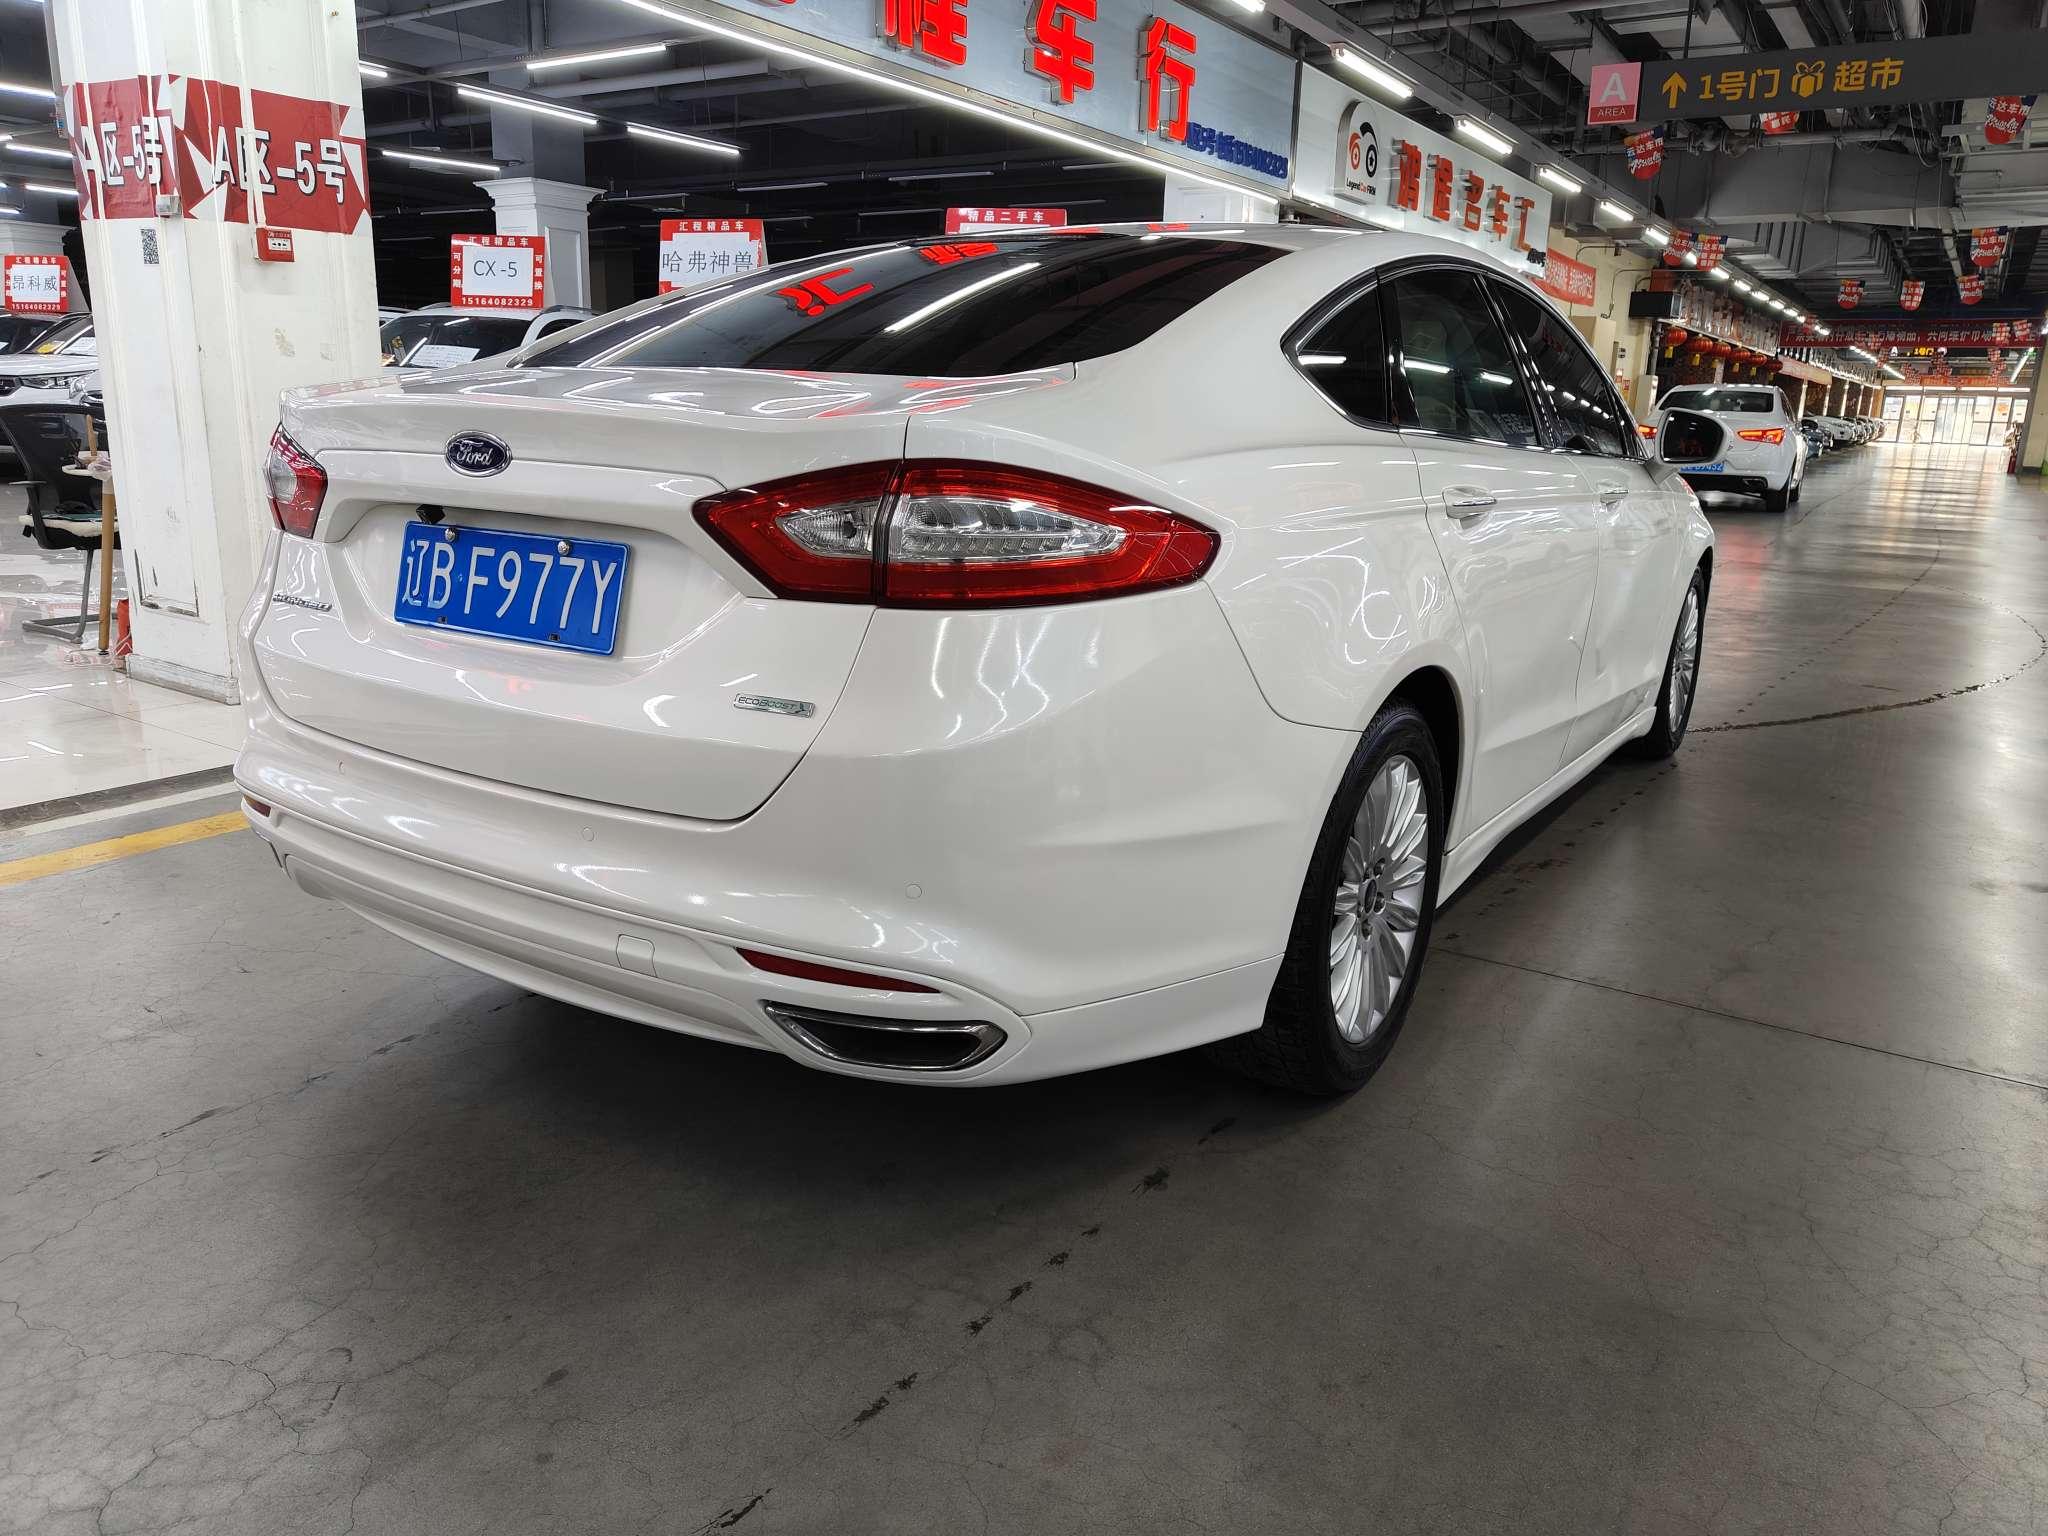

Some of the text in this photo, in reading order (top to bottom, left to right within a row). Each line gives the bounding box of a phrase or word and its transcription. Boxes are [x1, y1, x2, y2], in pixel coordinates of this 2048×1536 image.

[1600, 72, 1627, 103] A
[1699, 69, 1781, 100] 1号门
[1833, 58, 1904, 92] 超市
[1597, 108, 1627, 118] AREA
[80, 116, 163, 186] A区-5号
[213, 126, 346, 204] A区-5号
[679, 221, 744, 231] 汇程精品车
[967, 210, 1044, 222] 精品二手车
[661, 249, 754, 274] 哈弗神兽
[13, 274, 58, 292] 昂科威
[462, 296, 534, 306] 15164082329
[450, 439, 495, 467] Ford
